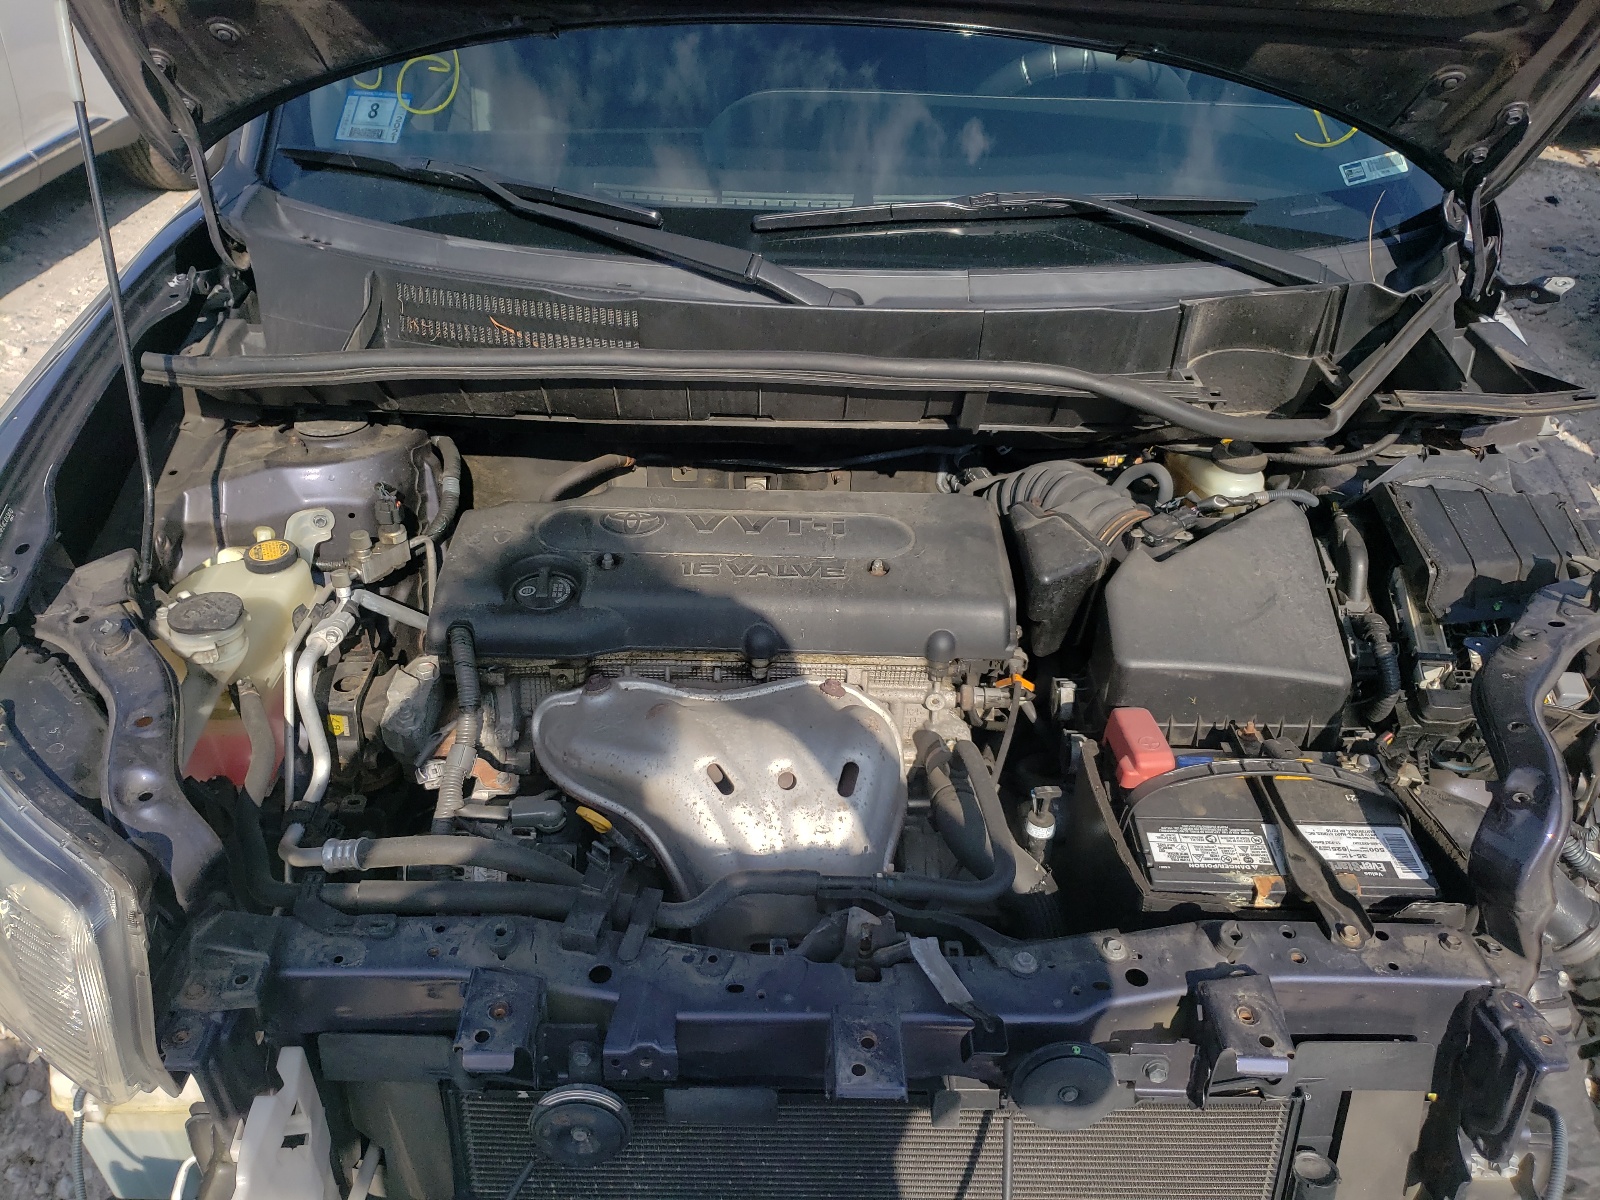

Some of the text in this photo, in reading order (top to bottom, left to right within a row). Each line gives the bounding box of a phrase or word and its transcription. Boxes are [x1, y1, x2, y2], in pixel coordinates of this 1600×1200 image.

[368, 102, 380, 119] 8
[685, 514, 846, 537] VVT-i
[682, 561, 848, 579] 16 VALVE
[1344, 794, 1358, 802] 21
[1329, 861, 1387, 872] EverStart
